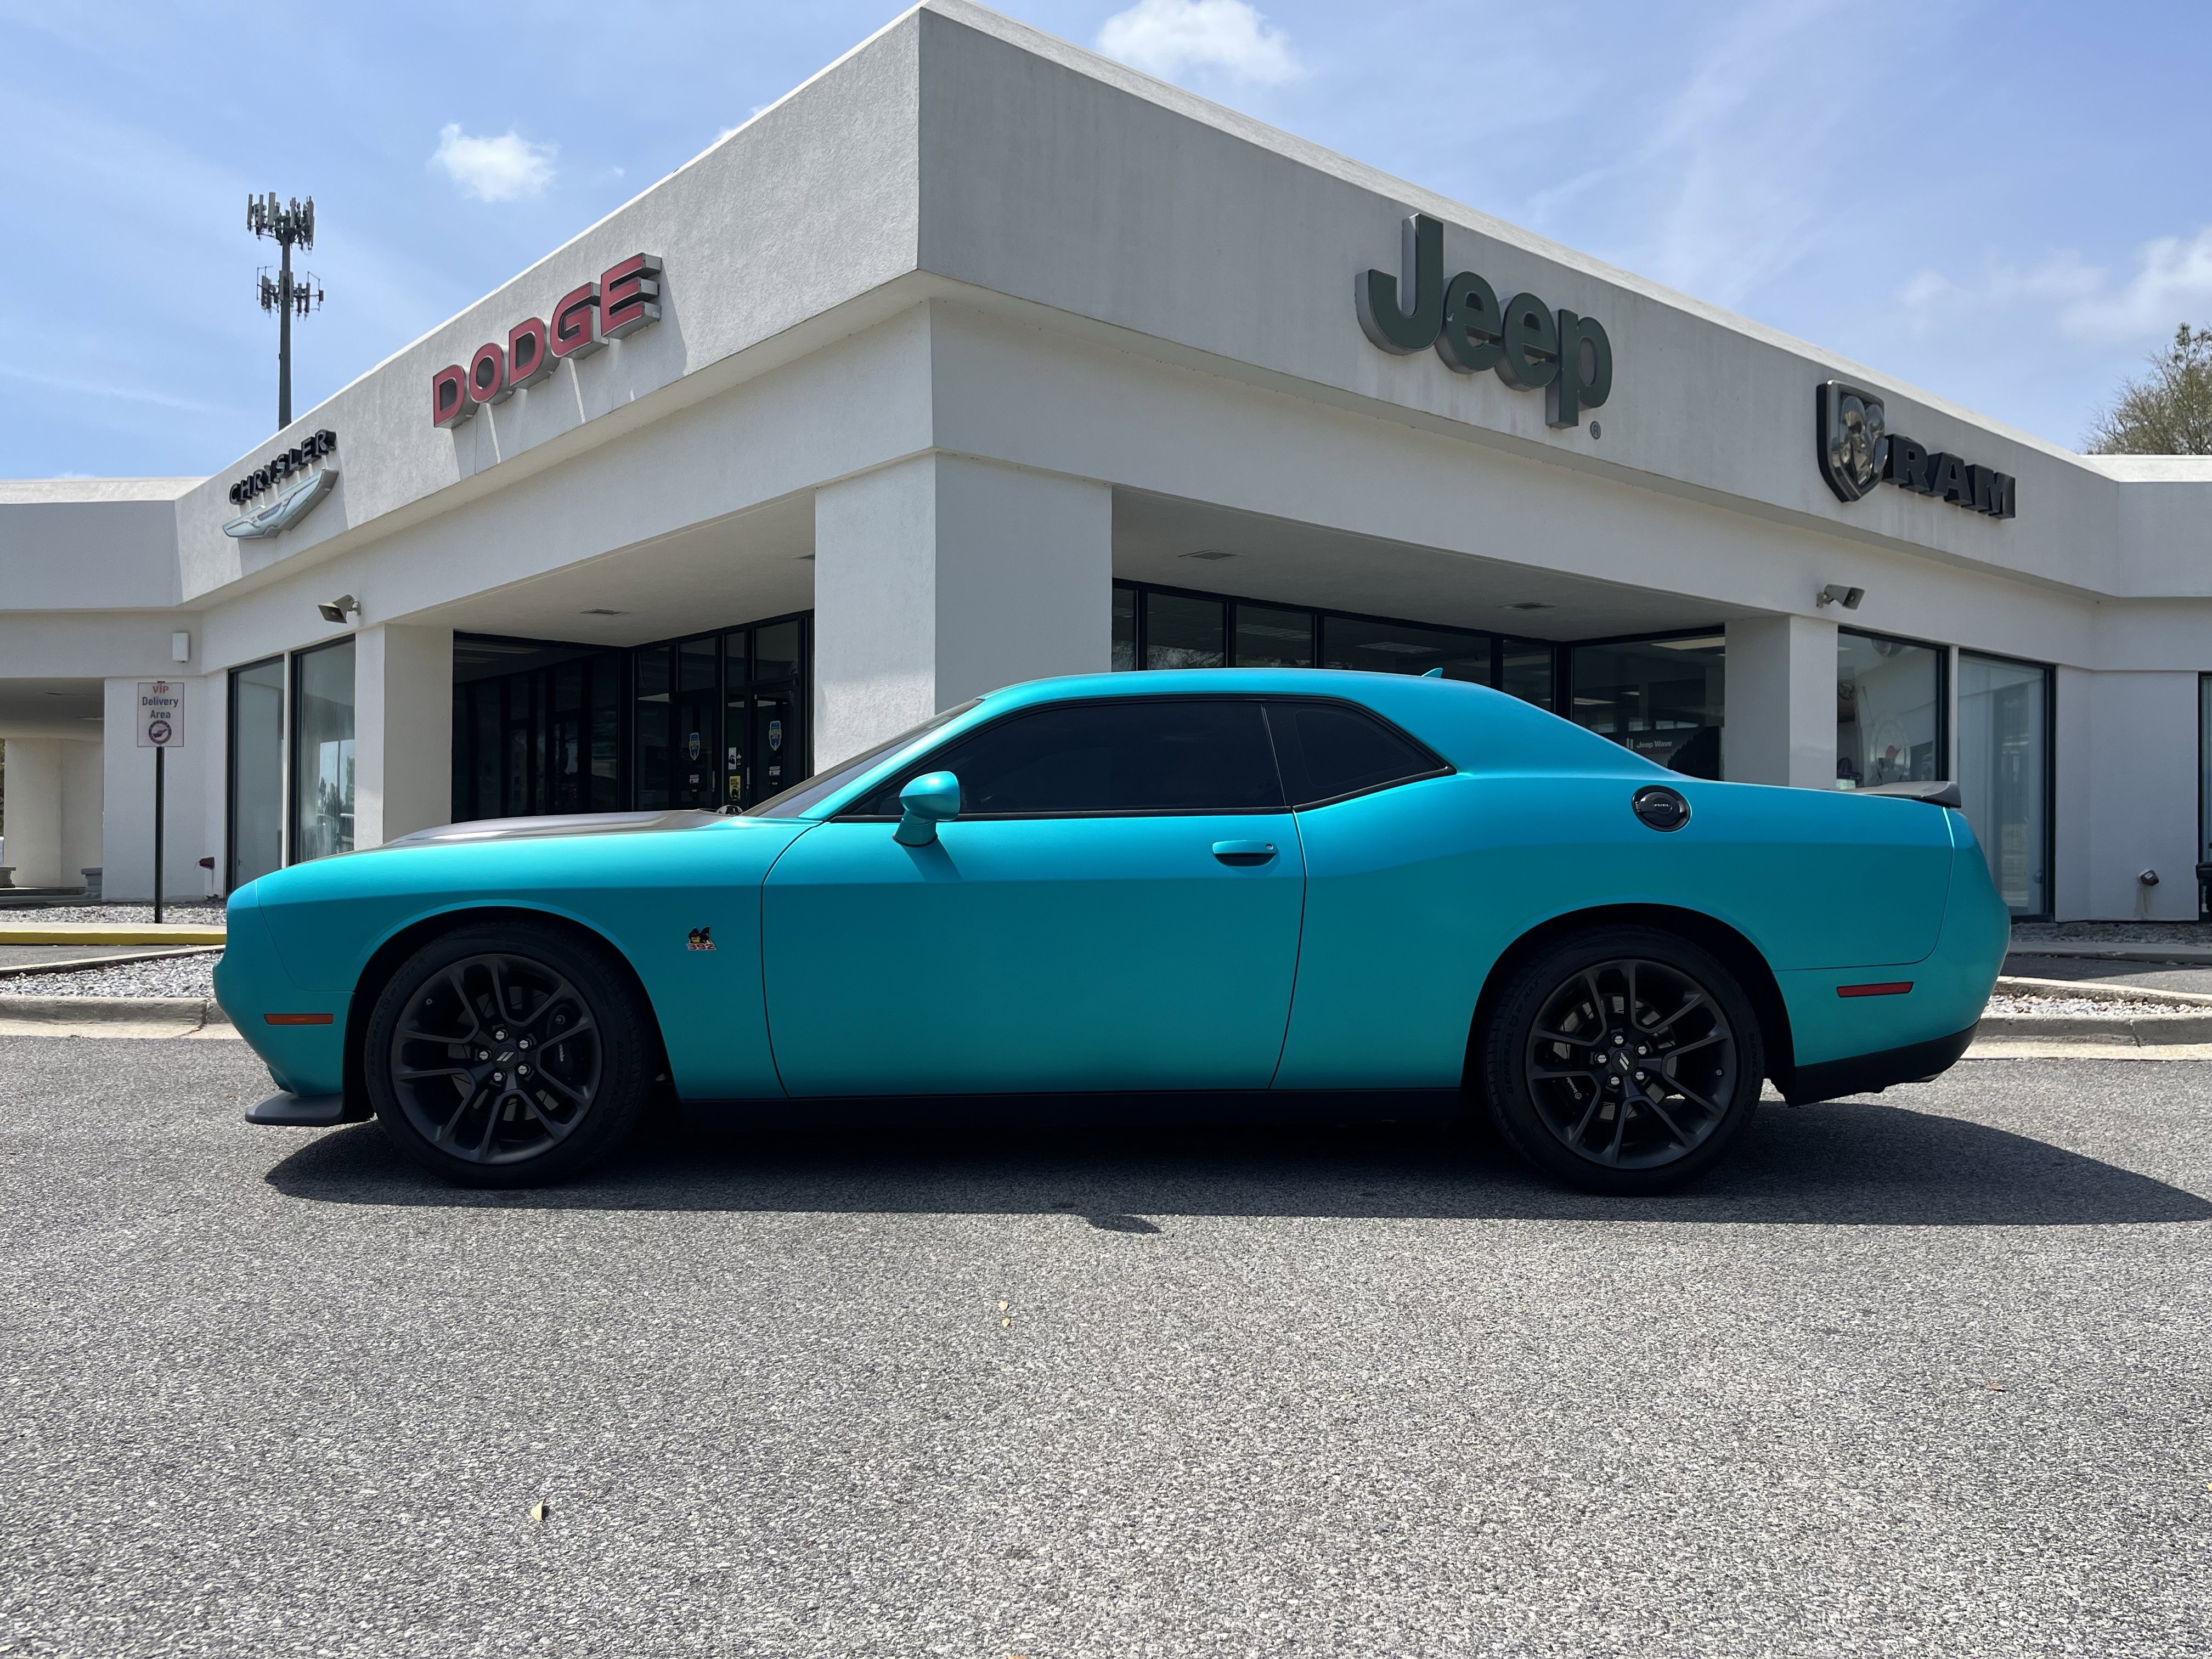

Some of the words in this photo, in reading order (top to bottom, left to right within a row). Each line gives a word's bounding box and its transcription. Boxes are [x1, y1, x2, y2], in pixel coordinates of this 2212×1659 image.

[433, 252, 659, 428] DODGE
[1356, 213, 1612, 429] Jeep
[229, 429, 336, 505] CHRYSLER
[1885, 433, 2016, 519] RAM
[143, 696, 179, 708] Delivery
[150, 710, 171, 719] Area
[153, 685, 169, 693] VIP
